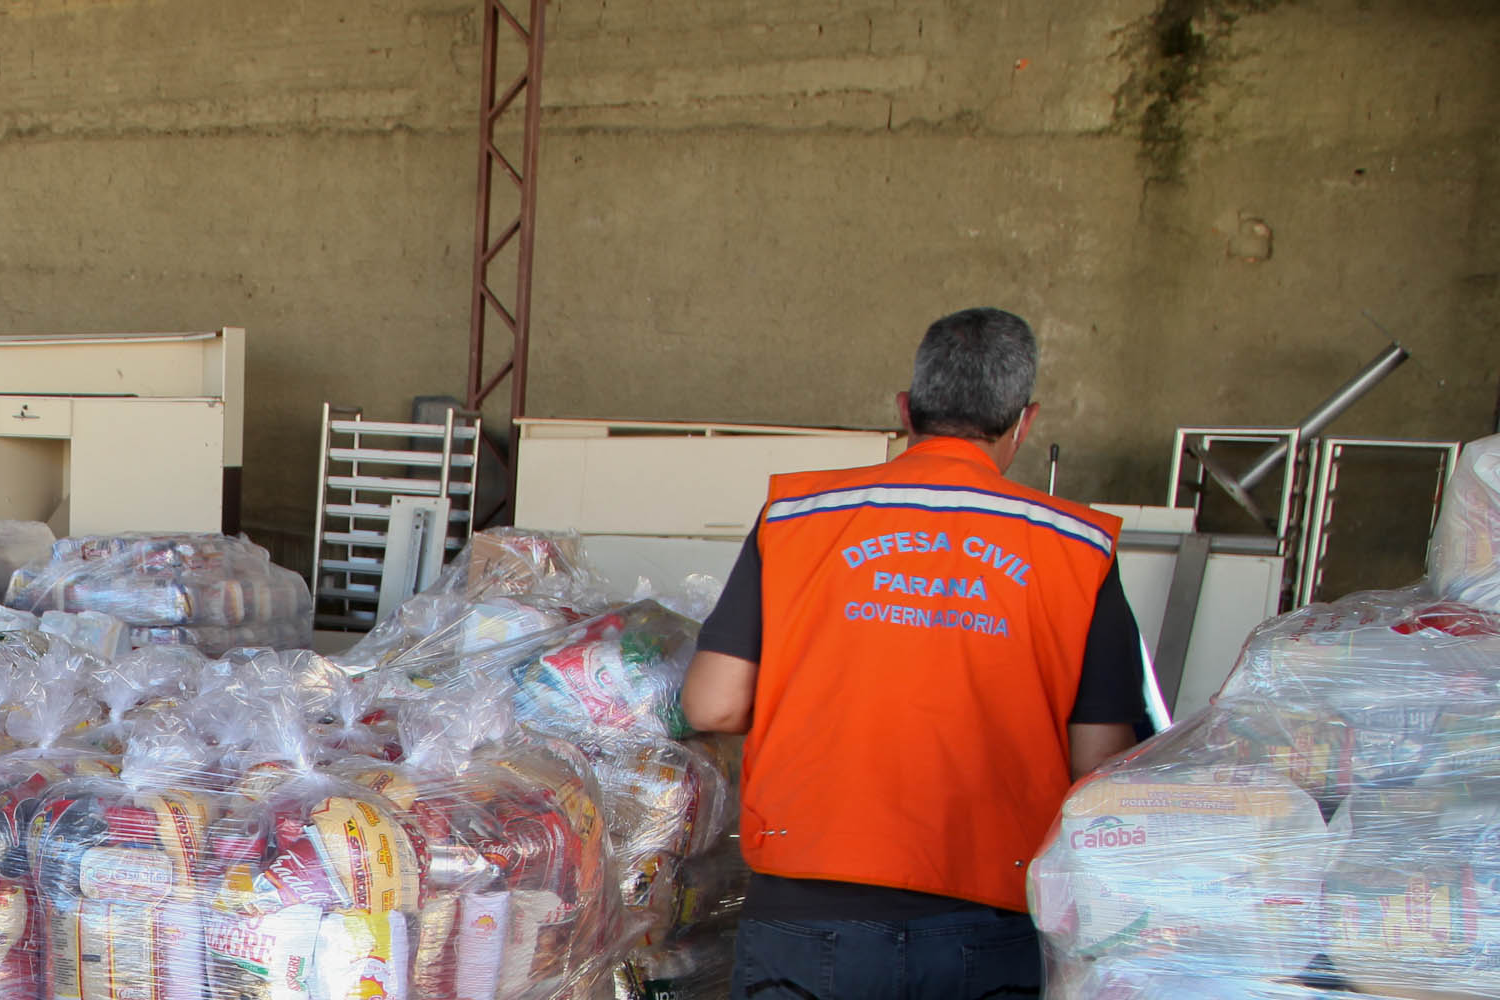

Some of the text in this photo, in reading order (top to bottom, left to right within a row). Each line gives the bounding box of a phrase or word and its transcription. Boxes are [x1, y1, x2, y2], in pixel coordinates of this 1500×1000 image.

[841, 531, 1032, 587] DEFESA CIVIL
[873, 571, 988, 601] PARANÁ
[844, 601, 1009, 637] GOVERNADORIA
[1070, 825, 1147, 850] Caiobá
